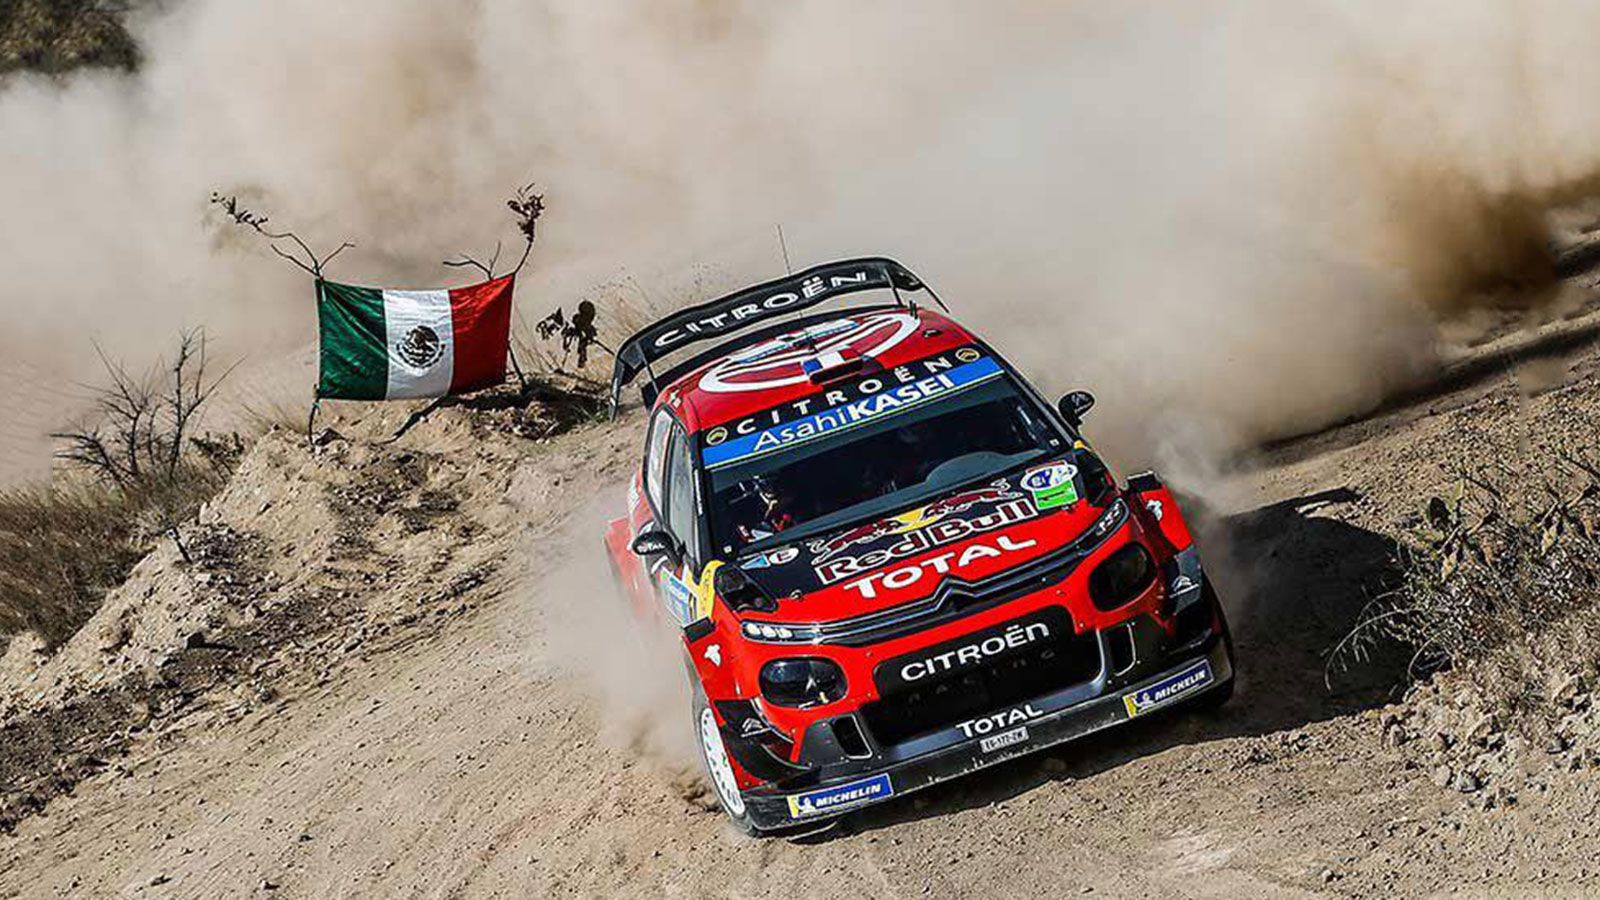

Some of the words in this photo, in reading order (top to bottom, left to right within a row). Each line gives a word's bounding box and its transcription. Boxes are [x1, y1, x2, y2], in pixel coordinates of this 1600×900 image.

[654, 272, 866, 347] CITROËN
[736, 356, 953, 435] CITROËN
[753, 373, 955, 451] AsahiKASEI
[814, 531, 930, 585] Red
[929, 499, 1038, 545] Bull
[844, 536, 1037, 598] TOTAL
[900, 623, 1050, 681] CITROËN
[1154, 668, 1207, 700] MICHELIN
[956, 704, 1044, 738] TOTAL
[815, 784, 882, 807] MICHELIN
